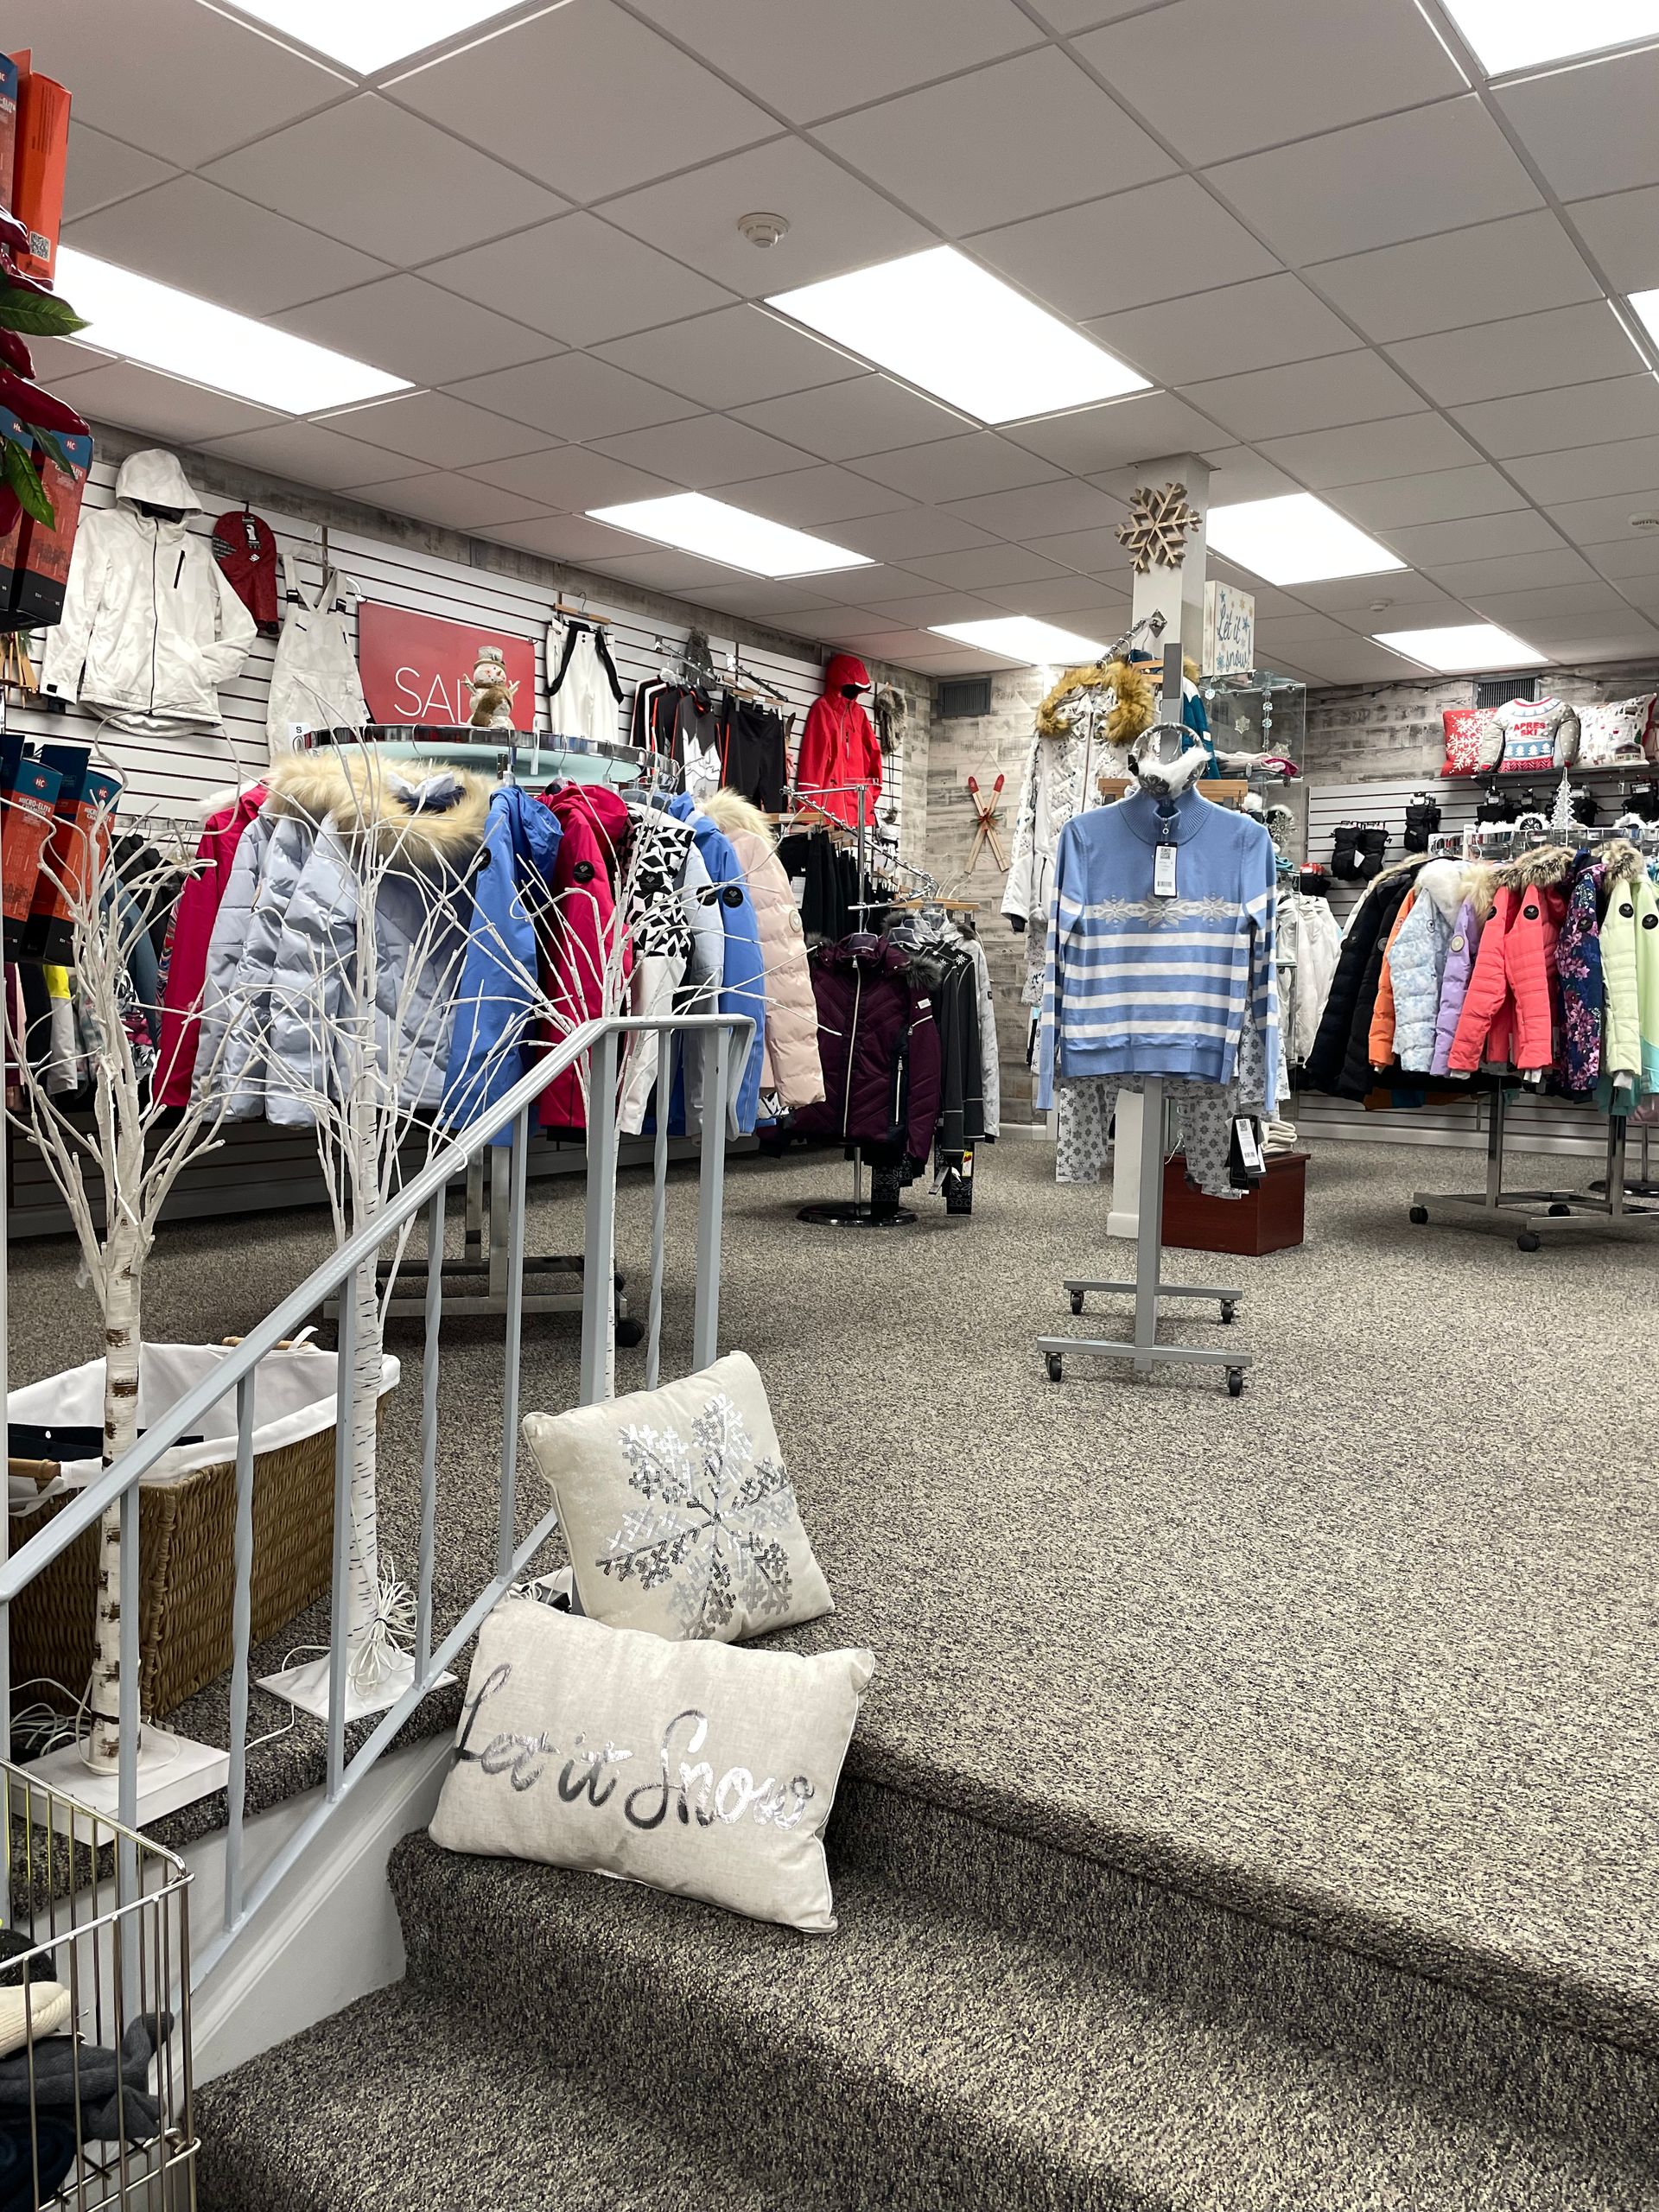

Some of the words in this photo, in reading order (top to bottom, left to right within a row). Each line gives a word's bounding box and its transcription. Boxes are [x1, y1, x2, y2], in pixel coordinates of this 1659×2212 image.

[67, 441, 76, 450] HC
[1217, 603, 1232, 641] Let
[1233, 615, 1241, 645] it
[394, 666, 471, 727] SAL
[1514, 721, 1546, 731] APRES
[35, 779, 46, 787] HC
[99, 789, 108, 798] HC
[18, 797, 52, 813] MICRO-ELITE
[454, 1662, 561, 1792] Let
[557, 1731, 635, 1808] it
[623, 1708, 816, 1831] Snow
